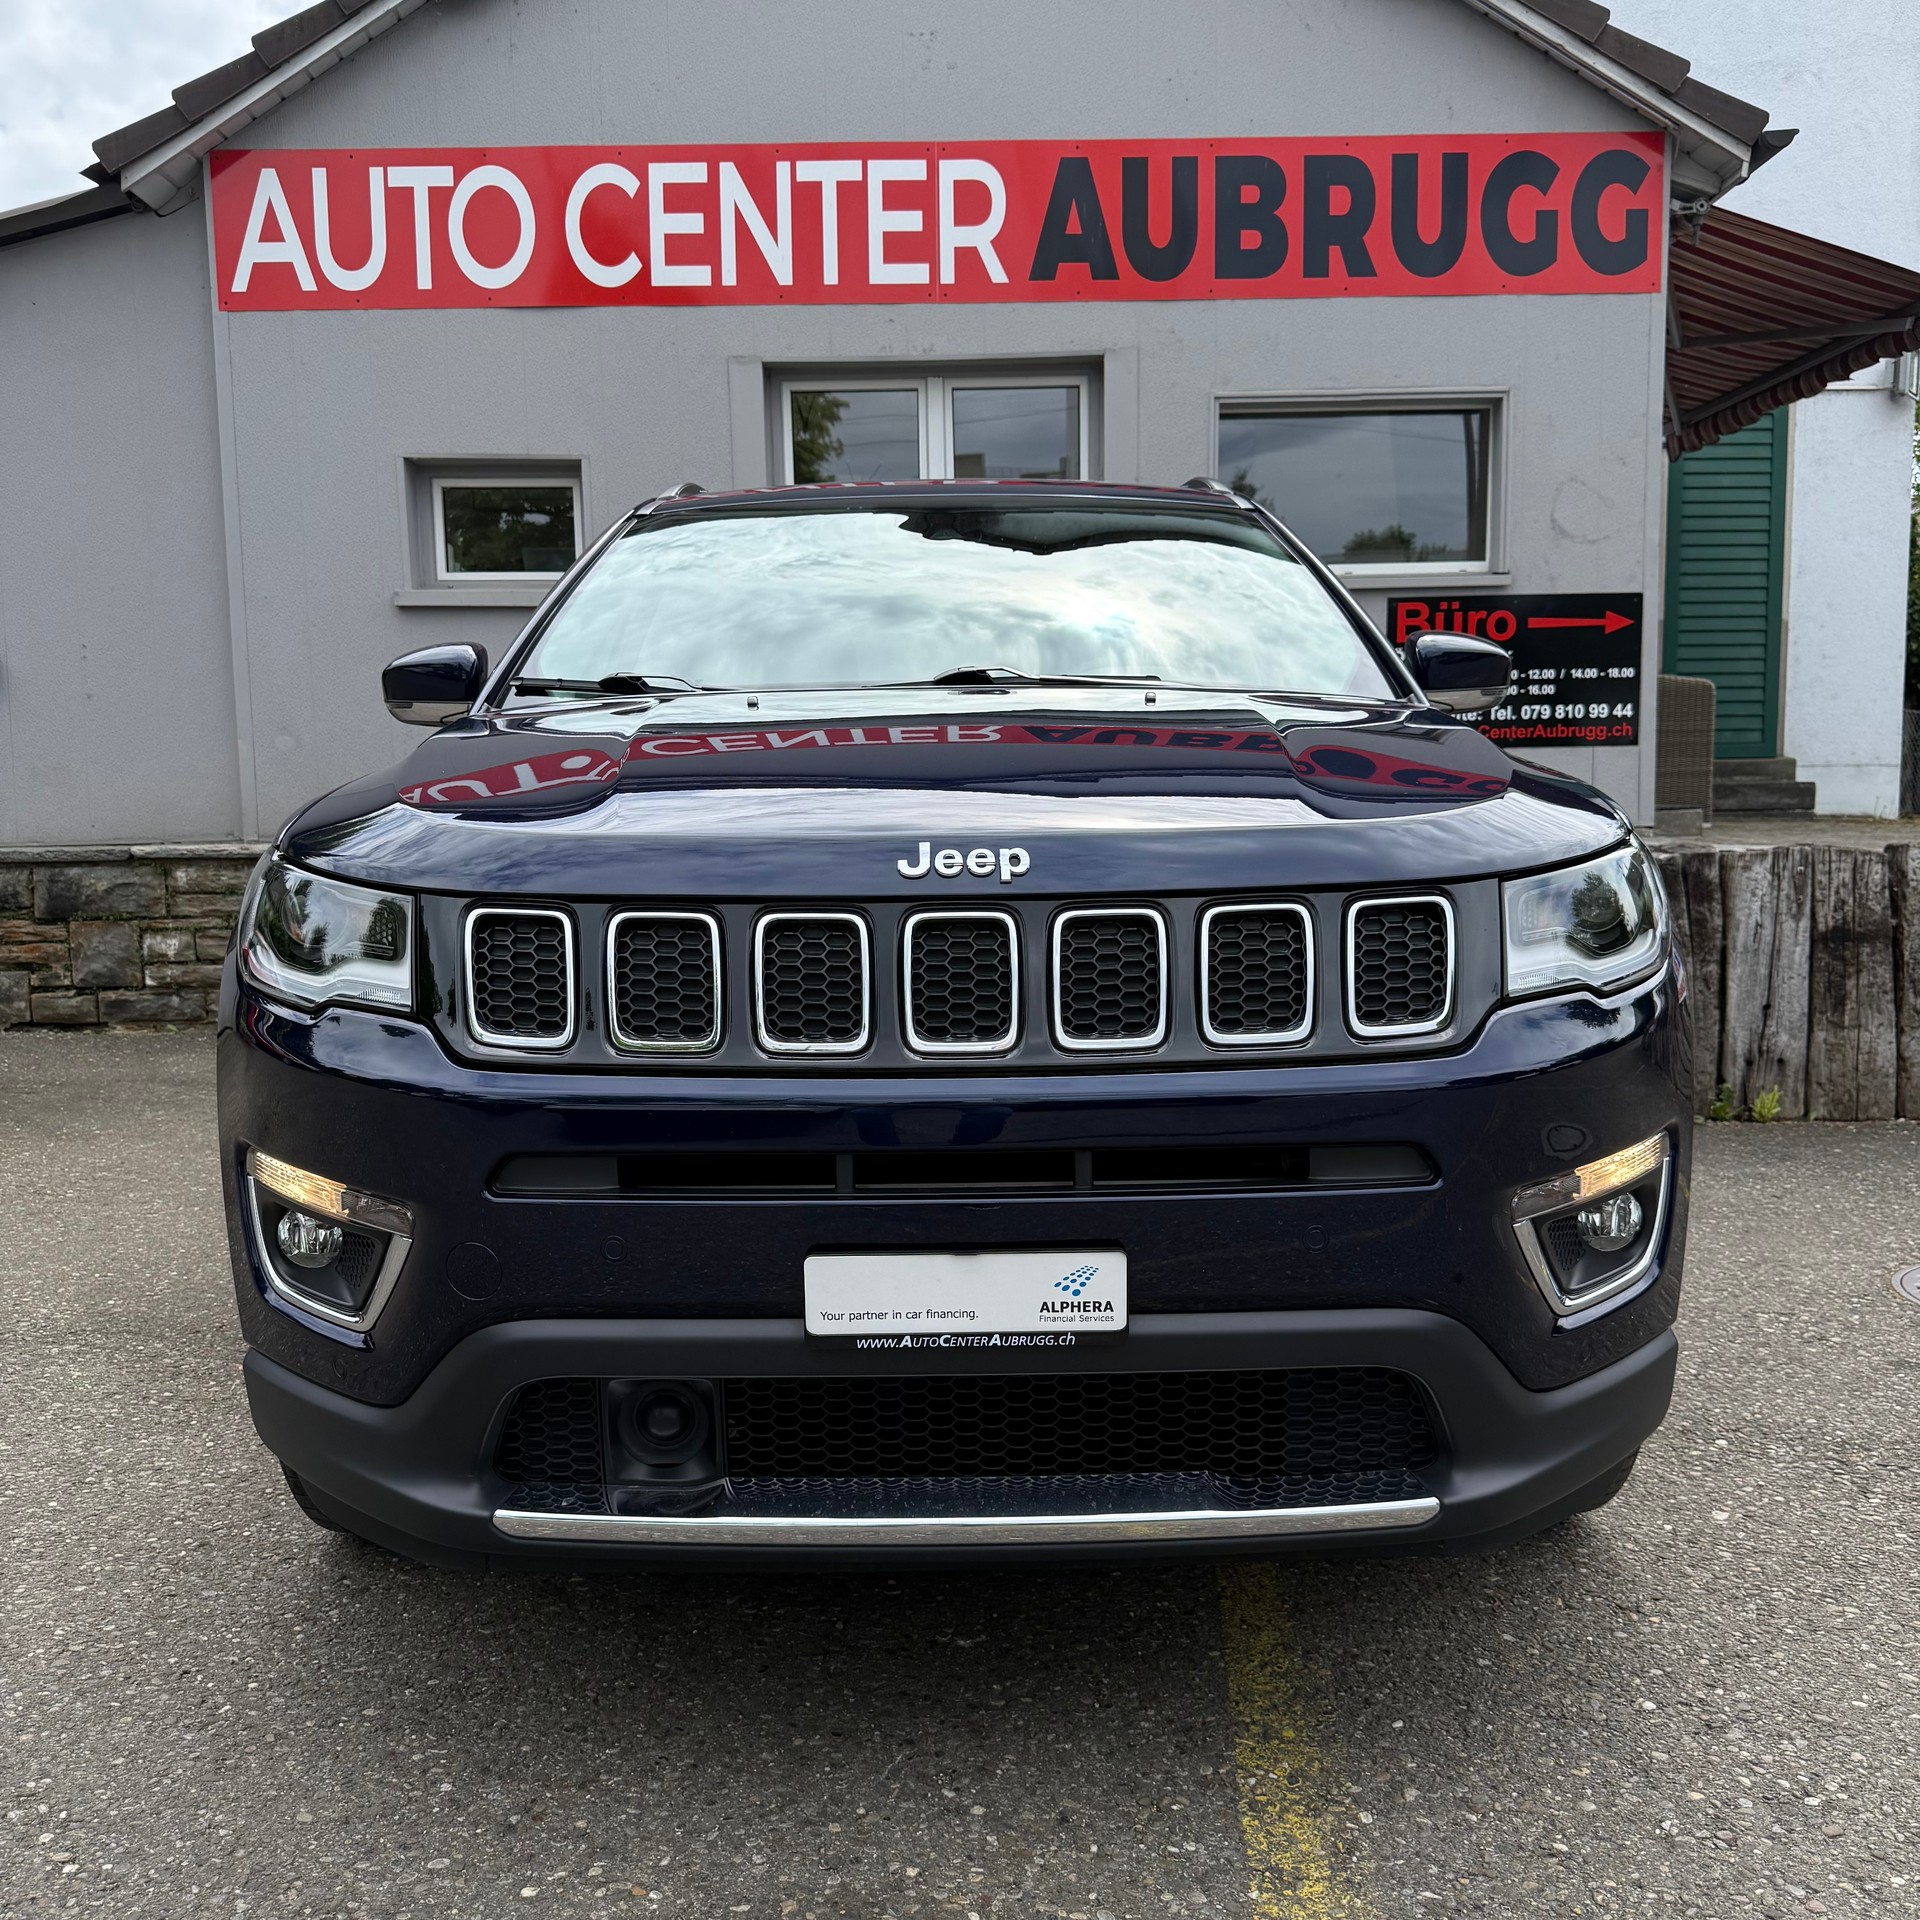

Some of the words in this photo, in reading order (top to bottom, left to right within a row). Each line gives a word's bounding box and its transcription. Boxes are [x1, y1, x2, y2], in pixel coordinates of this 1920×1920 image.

[231, 163, 536, 293] AUTO
[565, 159, 1009, 288] CENTER
[1028, 149, 1652, 282] AUBRUGG
[1396, 601, 1517, 644] Büro
[1527, 668, 1557, 680] 12.00
[1570, 667, 1599, 680] 14.00
[1607, 666, 1636, 679] 18.00
[1527, 684, 1556, 696] 16.00
[1490, 704, 1518, 721] Tel.
[1520, 704, 1552, 720] 079
[1554, 703, 1585, 719] 810
[1588, 703, 1610, 718] 99
[1611, 702, 1635, 718] 44
[1478, 722, 1633, 740] CenterAubrugg.ch
[897, 841, 1031, 884] Jeep
[1039, 1300, 1115, 1313] ALPHERA
[819, 1310, 846, 1321] Your
[848, 1310, 889, 1323] partner
[892, 1309, 902, 1320] in
[905, 1311, 923, 1320] car
[926, 1308, 979, 1321] financing.
[1039, 1314, 1076, 1323] Financial
[1079, 1313, 1115, 1323] Services
